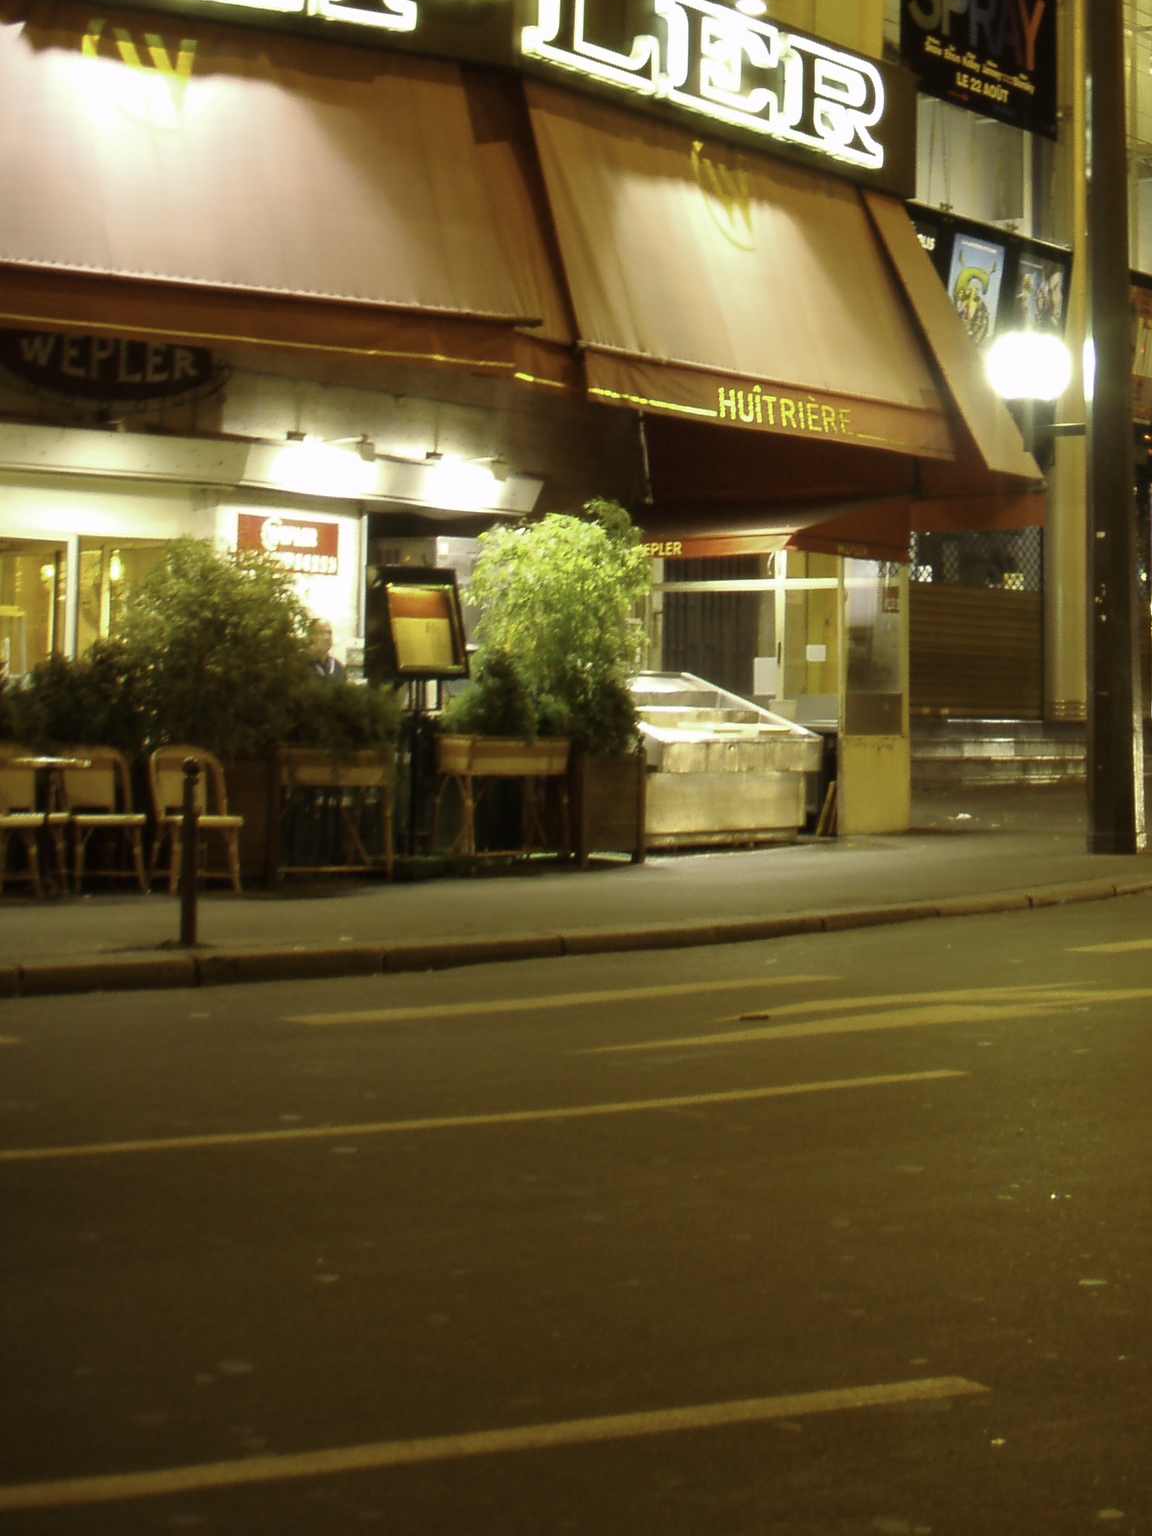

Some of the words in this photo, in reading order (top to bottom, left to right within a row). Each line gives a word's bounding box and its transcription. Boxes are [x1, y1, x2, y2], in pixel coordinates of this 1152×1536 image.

[955, 71, 969, 89] LE
[969, 77, 982, 94] 22
[982, 82, 1010, 104] AOÛT
[20, 336, 199, 383] WEPLER
[717, 384, 855, 437] HUÎTRIÈRE
